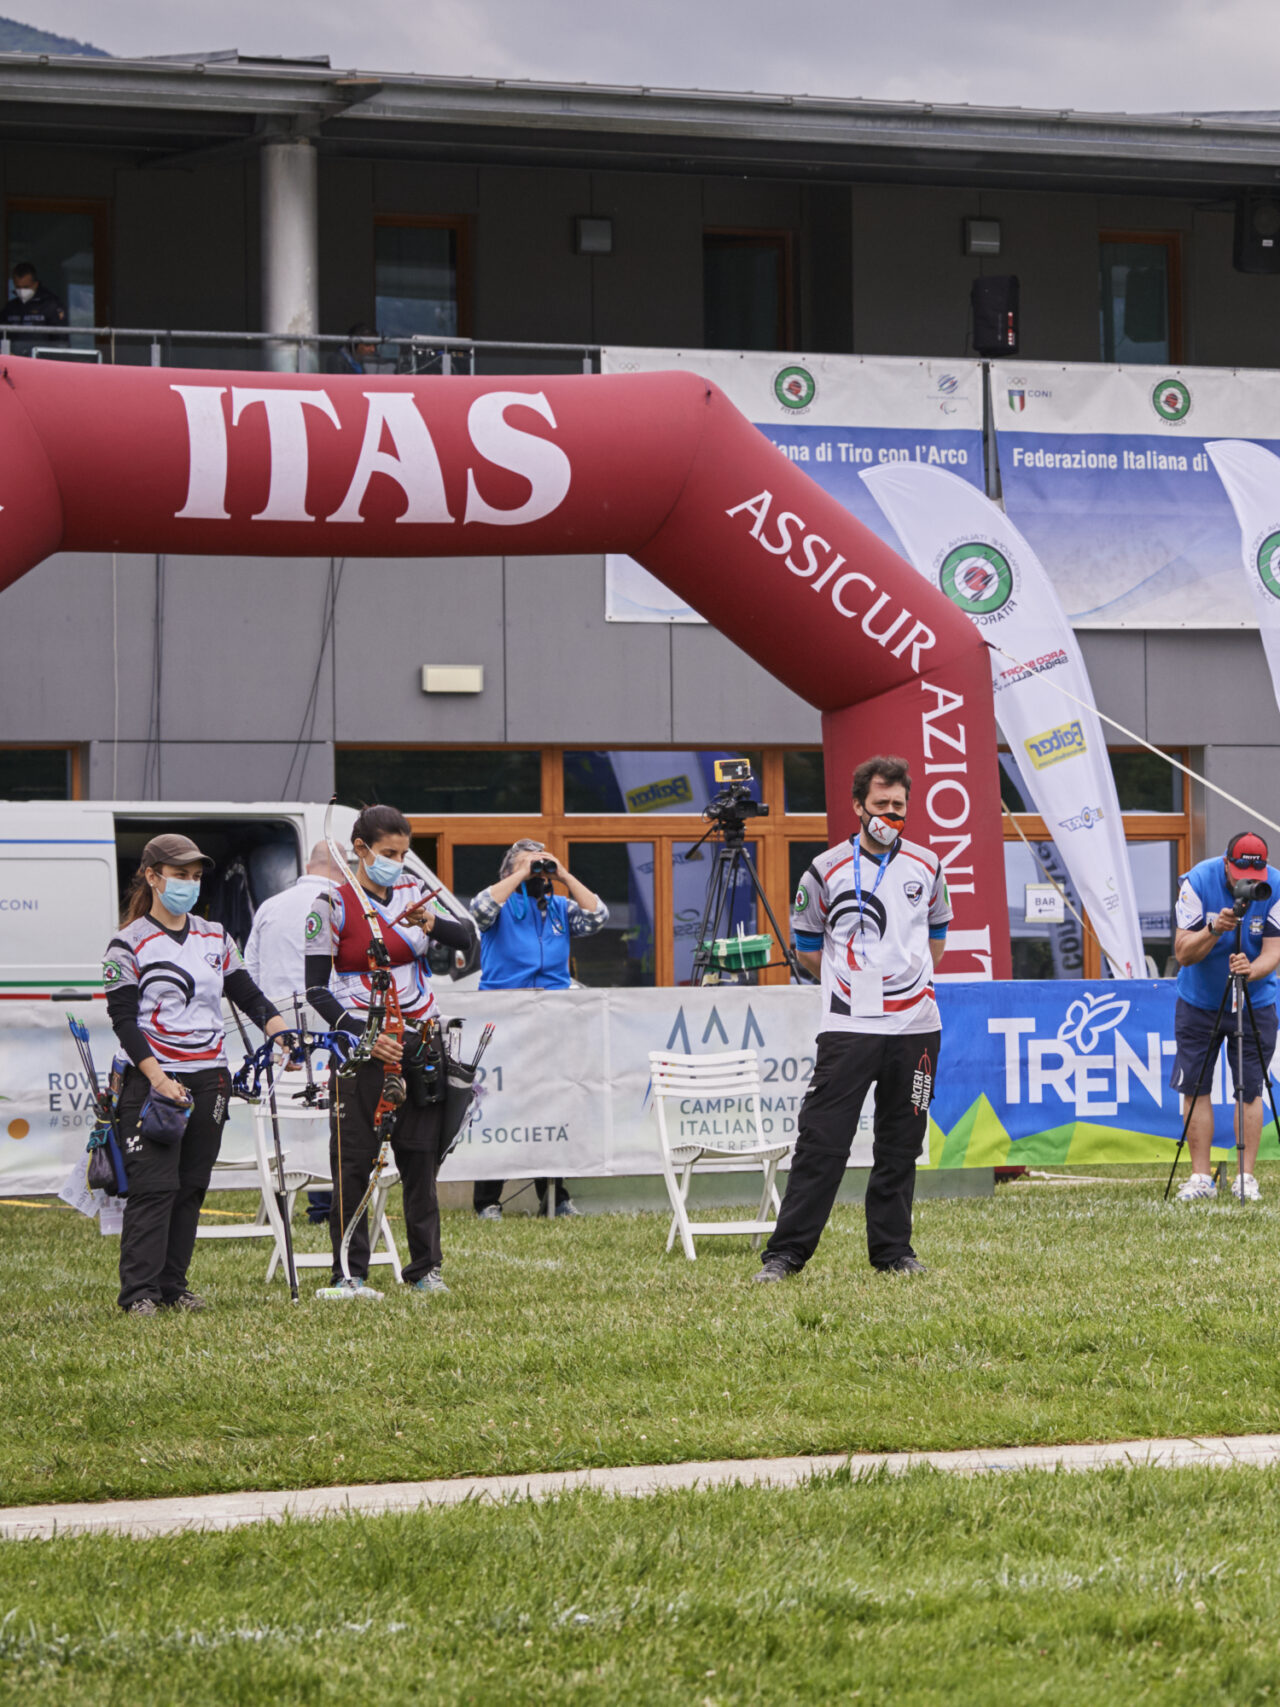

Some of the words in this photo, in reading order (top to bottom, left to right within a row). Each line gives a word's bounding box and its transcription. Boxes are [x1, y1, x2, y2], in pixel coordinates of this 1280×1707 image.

[1028, 390, 1052, 398] CONI
[170, 384, 571, 525] ITAS
[815, 443, 832, 462] di
[838, 443, 873, 463] Tiro
[878, 448, 909, 464] con
[915, 445, 968, 465] l'Arco
[1013, 447, 1118, 469] Federazione
[1123, 450, 1188, 471] Italiana
[1193, 453, 1209, 472] di
[1034, 897, 1056, 906] BAR
[763, 1057, 816, 1083] 202
[911, 1070, 924, 1107] ARCIERI
[920, 1074, 932, 1111] TIGULLIO
[681, 1117, 774, 1136] ITALIANO
